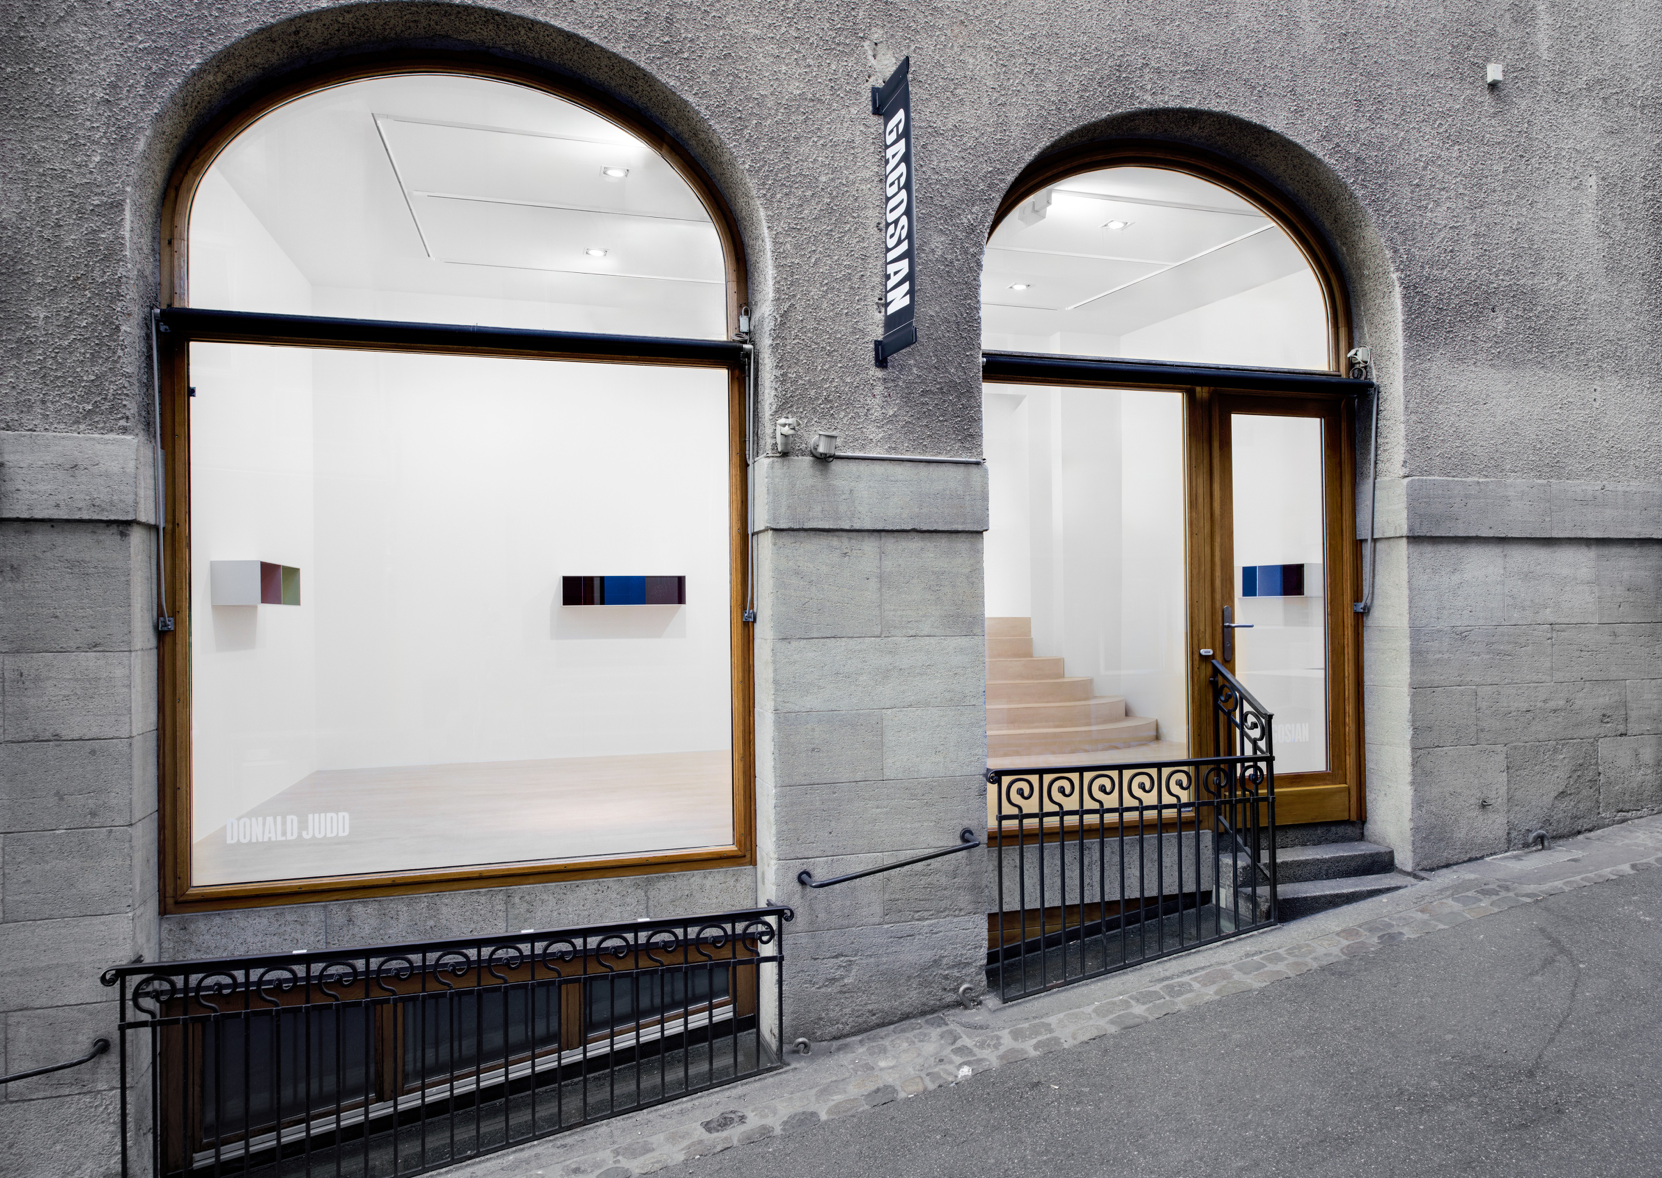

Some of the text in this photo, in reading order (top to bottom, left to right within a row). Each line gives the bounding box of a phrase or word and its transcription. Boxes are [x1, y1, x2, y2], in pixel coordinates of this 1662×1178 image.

[885, 107, 911, 316] GAGOSIAN
[1272, 722, 1310, 743] GOSIAN
[226, 811, 350, 844] DONALD JUDD
